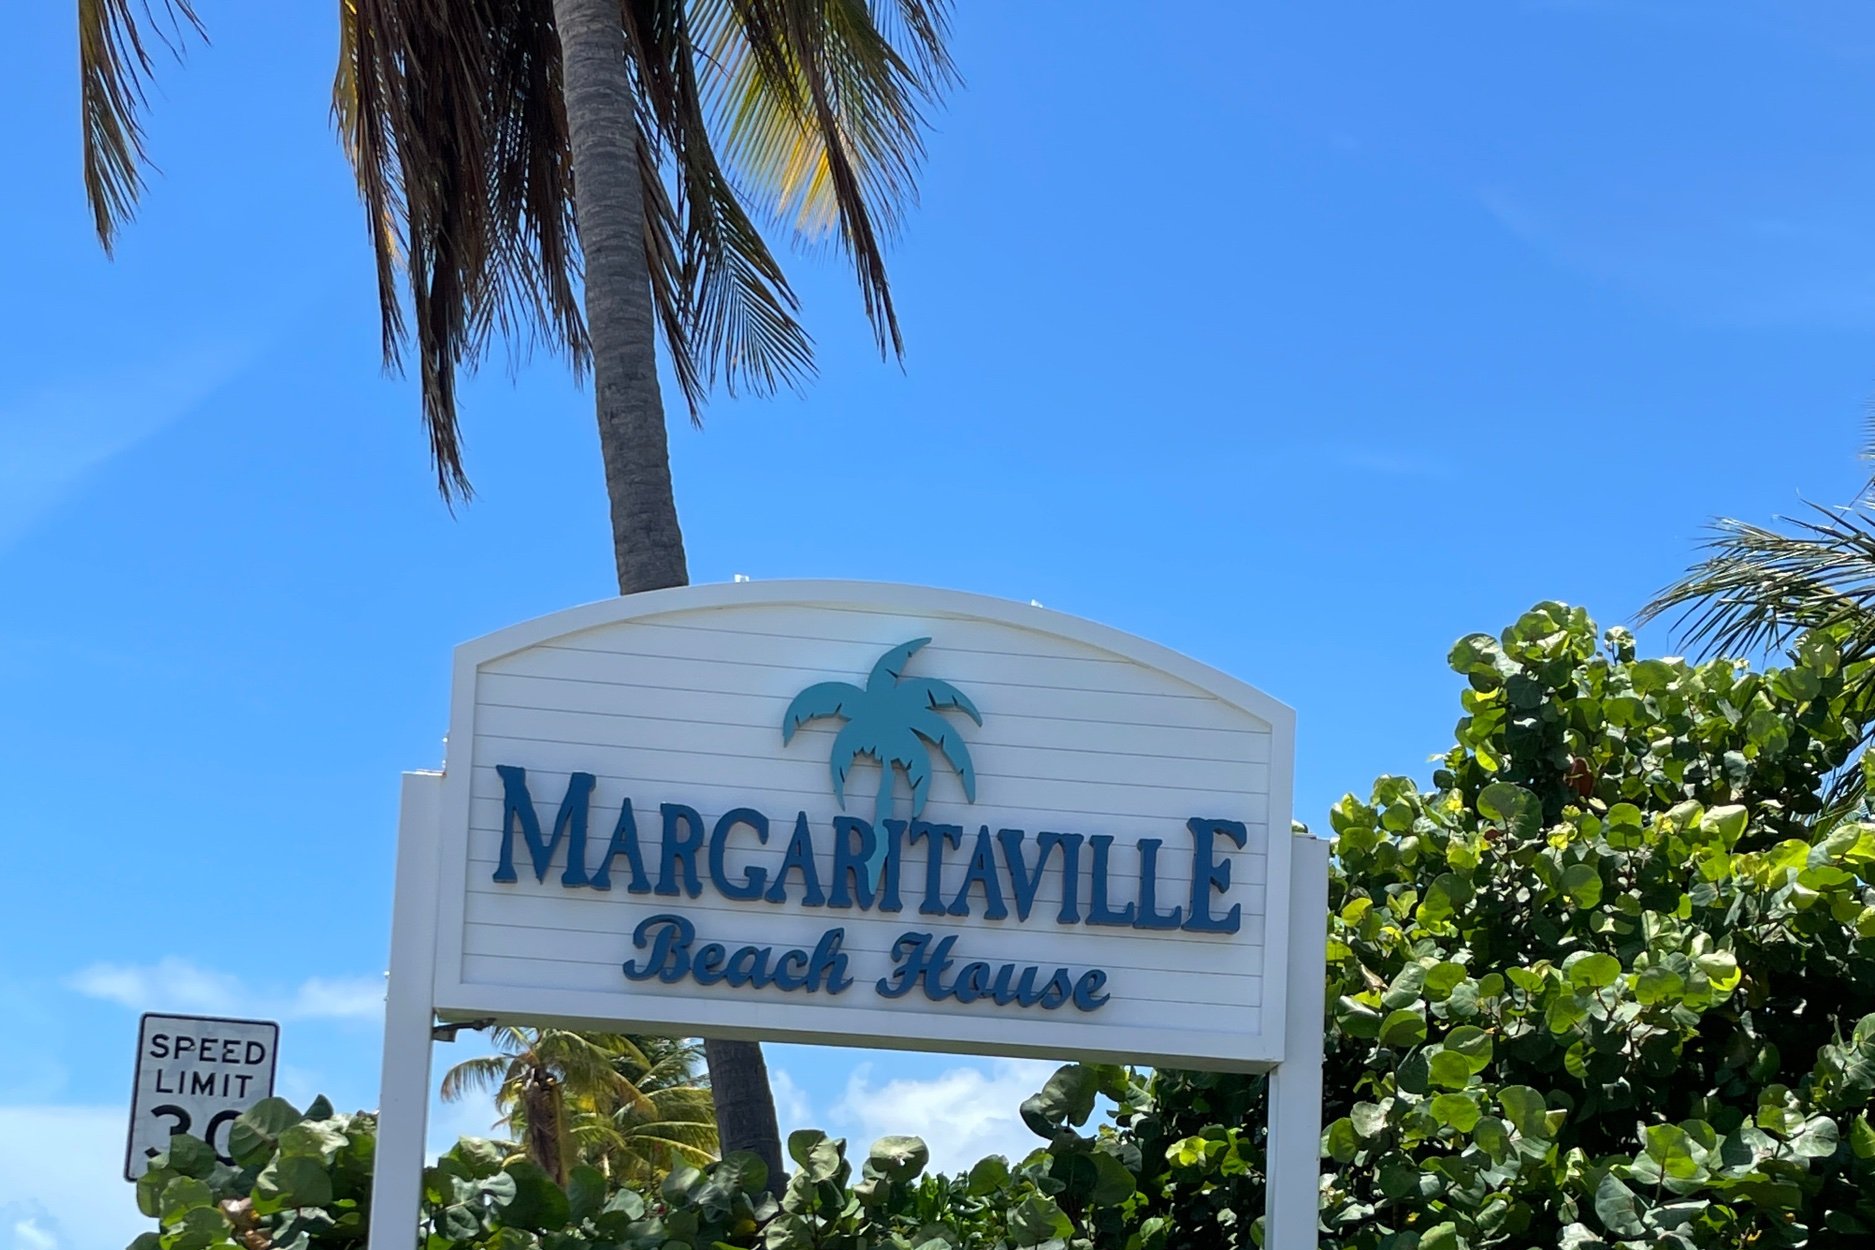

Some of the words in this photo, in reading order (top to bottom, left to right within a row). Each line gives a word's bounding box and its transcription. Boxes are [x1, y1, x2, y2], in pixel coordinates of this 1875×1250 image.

[492, 765, 1248, 934] MARGARITAVILLE
[622, 914, 854, 994] Beach
[876, 932, 1111, 1011] House
[150, 1033, 265, 1065] SPEED
[156, 1069, 253, 1099] LIMIT
